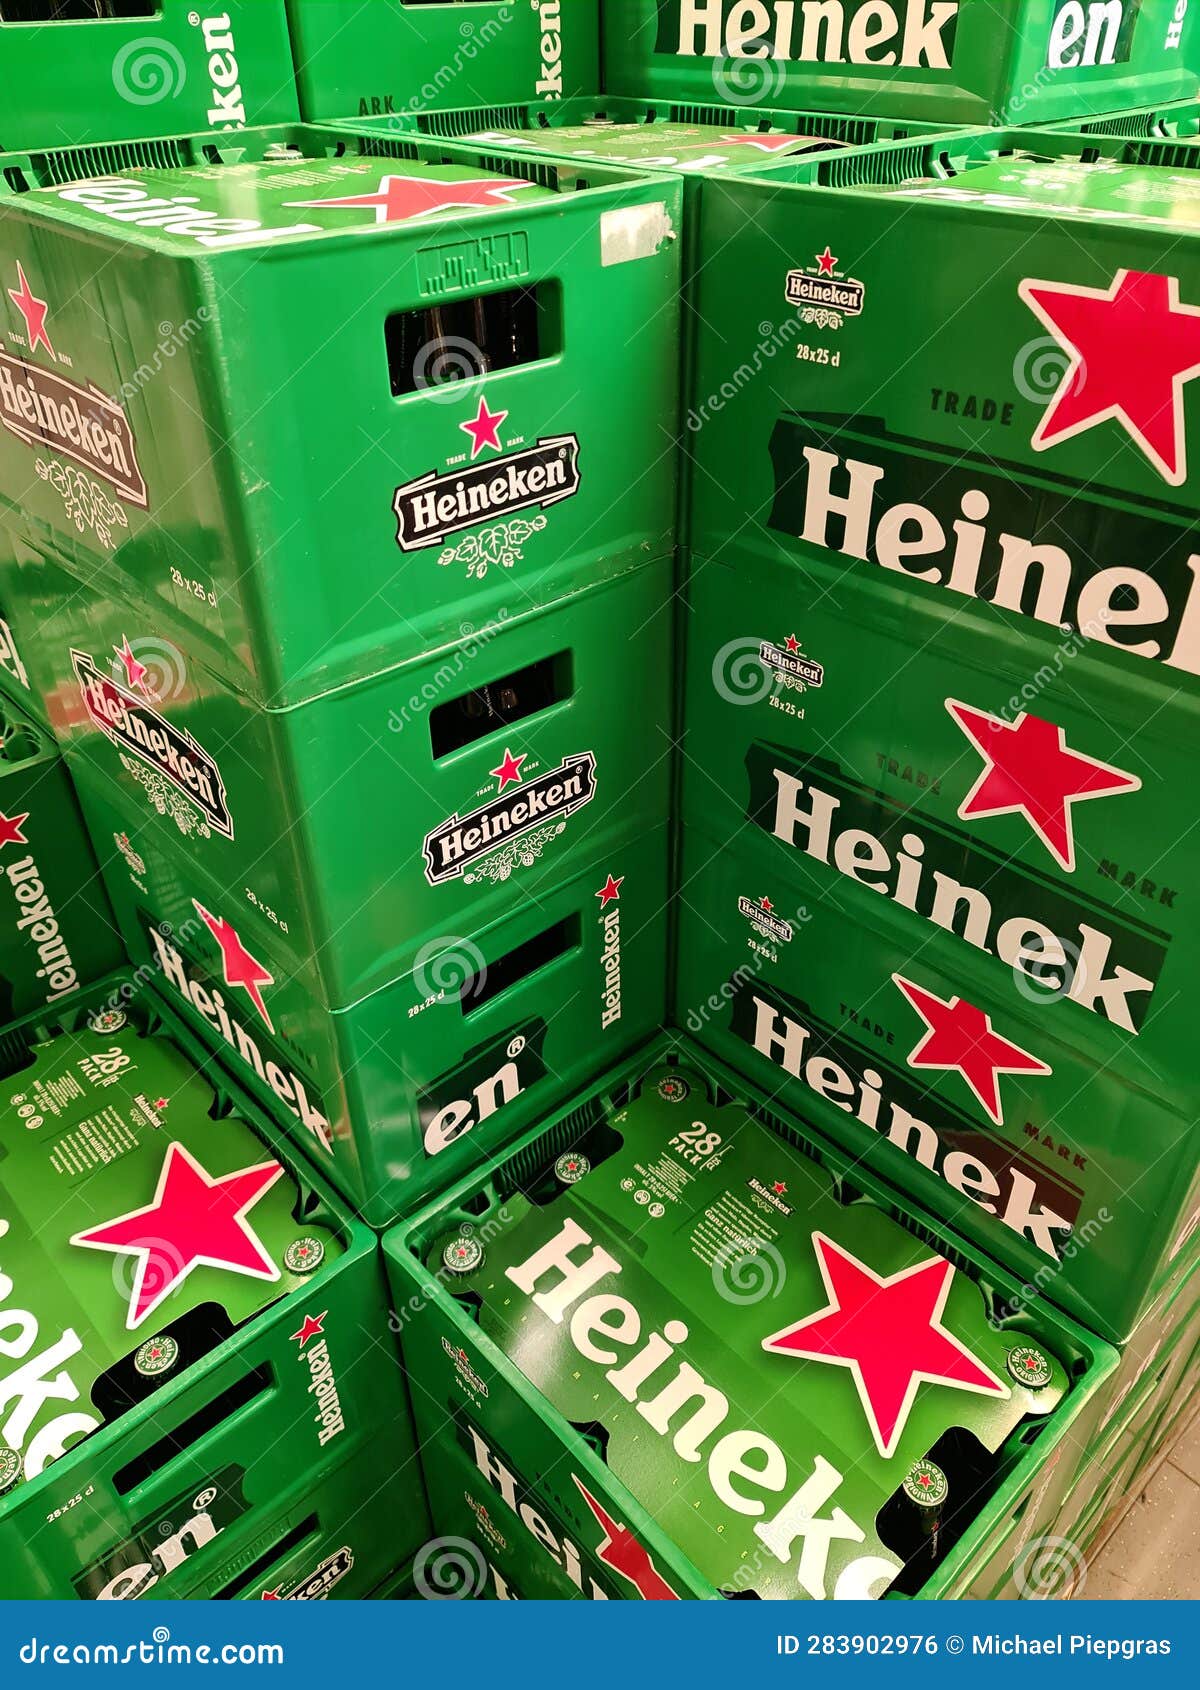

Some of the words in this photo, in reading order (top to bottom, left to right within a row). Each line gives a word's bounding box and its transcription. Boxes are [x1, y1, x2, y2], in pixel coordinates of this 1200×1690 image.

[535, 0, 563, 101] ken
[202, 11, 246, 130] ken
[790, 277, 859, 307] Heineken
[930, 388, 1015, 427] TRADE
[763, 646, 820, 681] Heineken
[875, 752, 942, 796] TRADE
[771, 768, 1154, 1035] Heinek
[1097, 859, 1178, 908] MARK
[742, 900, 791, 937] Heineken
[149, 926, 334, 1157] Heinek
[839, 1003, 896, 1046] TRADE
[77, 1058, 104, 1083] PACK
[90, 1047, 131, 1074] 28
[678, 1121, 722, 1155] 28
[752, 996, 1072, 1262] Heinek
[1023, 1122, 1088, 1172] MARK
[668, 1136, 702, 1166] PACK
[748, 1178, 792, 1215] Heineken
[705, 1209, 724, 1228] Ganz
[1012, 1348, 1048, 1367] Heineken
